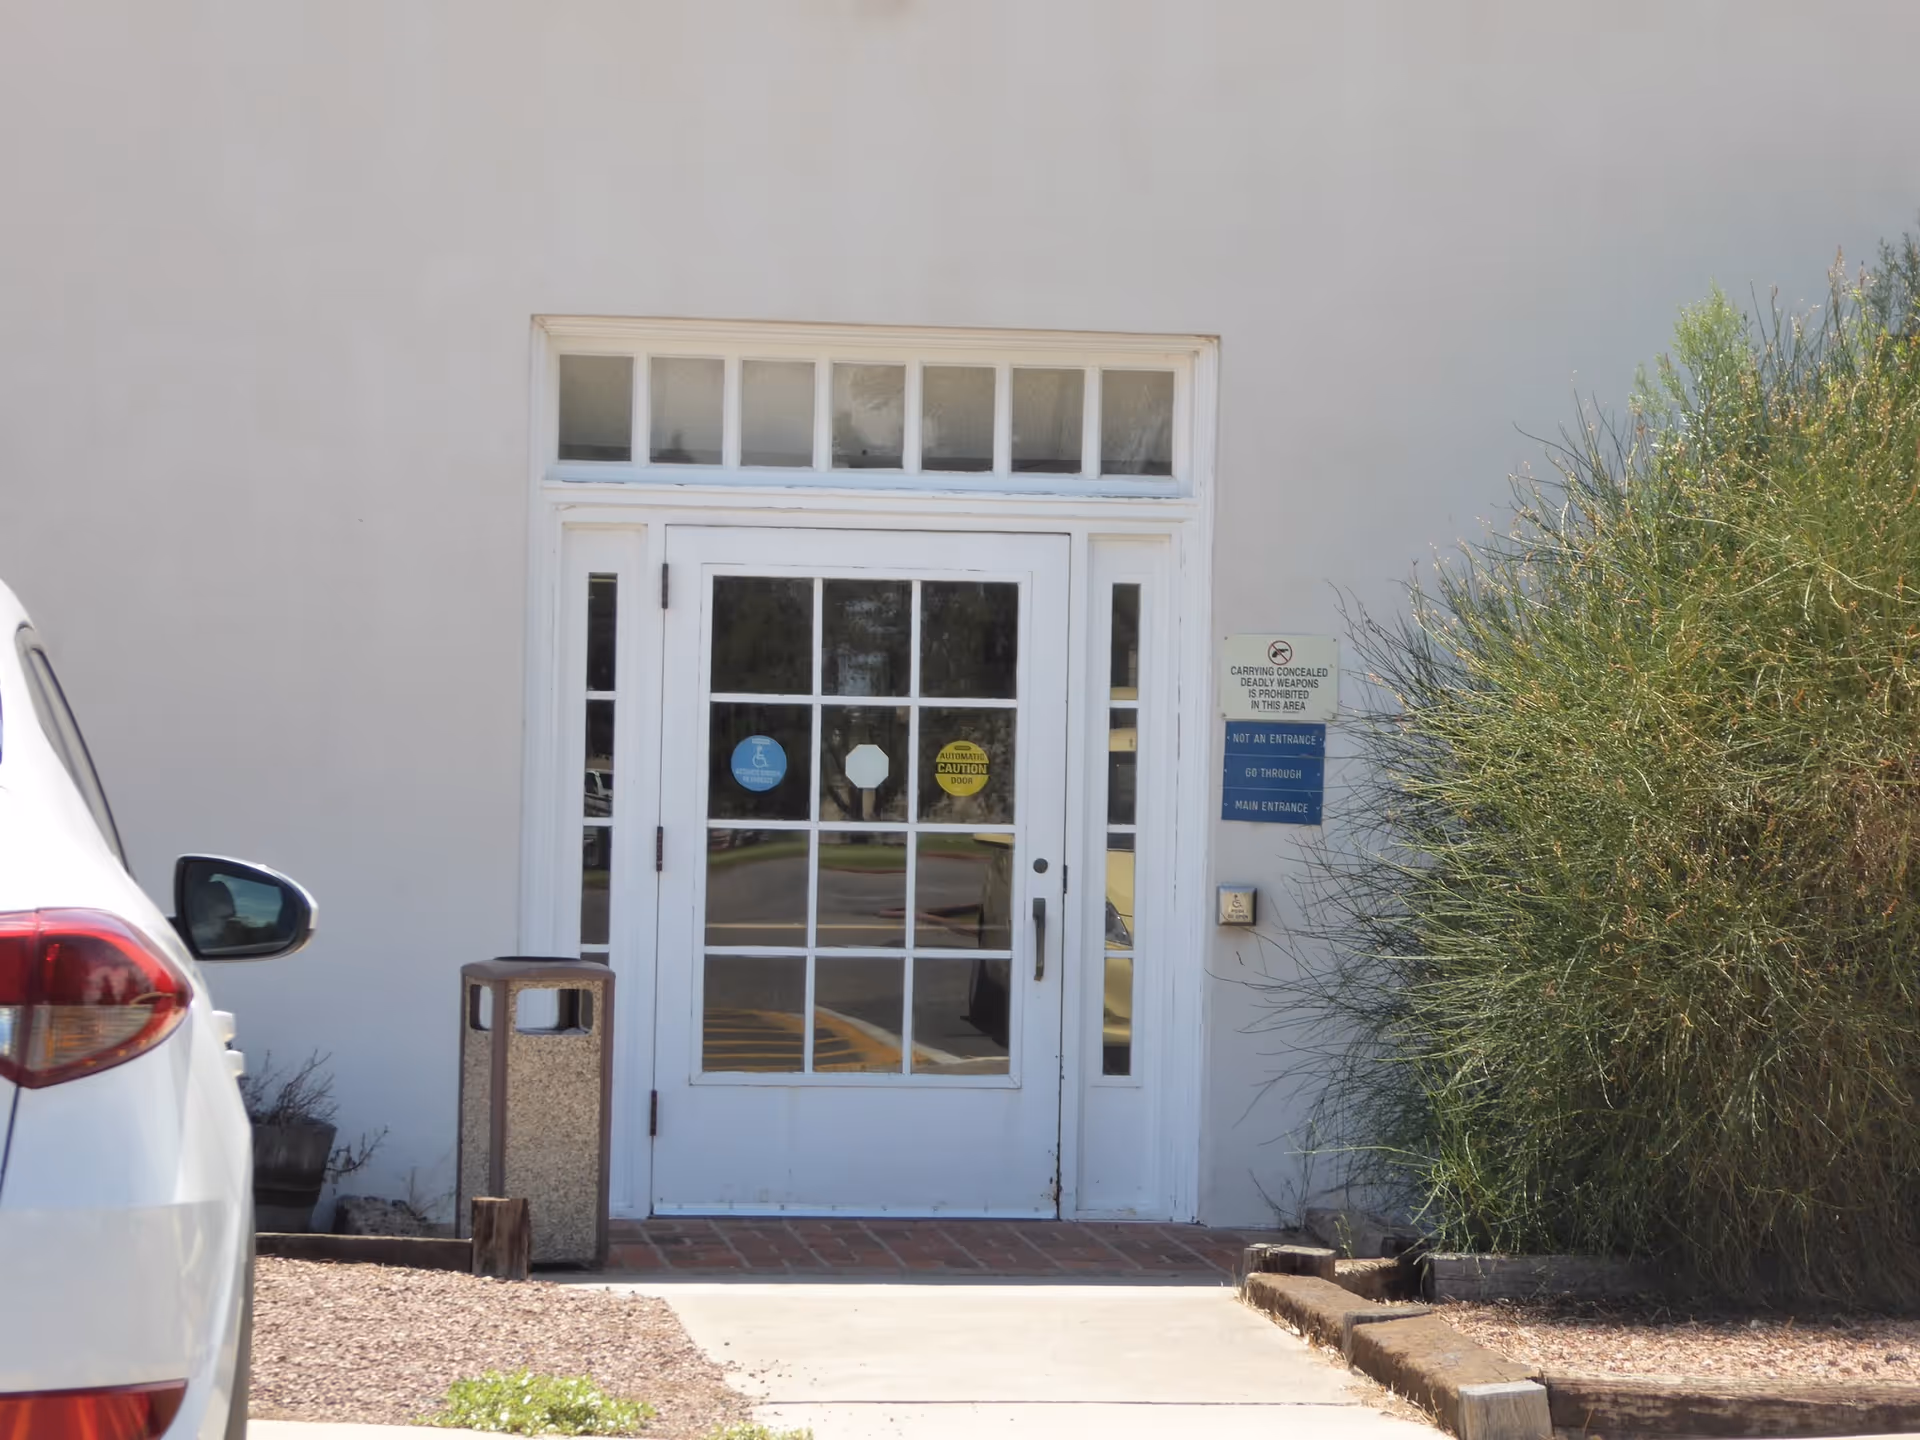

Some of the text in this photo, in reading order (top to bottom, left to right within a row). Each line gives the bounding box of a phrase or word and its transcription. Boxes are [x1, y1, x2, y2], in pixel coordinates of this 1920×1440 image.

[1230, 666, 1328, 678] CARRYING CONCEALED
[1240, 677, 1319, 689] DEADLY WEAPONS
[1248, 689, 1309, 700] IS PROHIBITED
[1251, 700, 1306, 711] IN THIS AREA
[1233, 733, 1317, 745] NOT AN ENTRANCE
[940, 752, 984, 761] AUTOMATIC
[938, 763, 987, 774] CAUTION
[1245, 767, 1302, 779] GO THROUGH
[951, 776, 973, 785] DOOR
[1235, 800, 1309, 813] MAIN ENTRANCE
